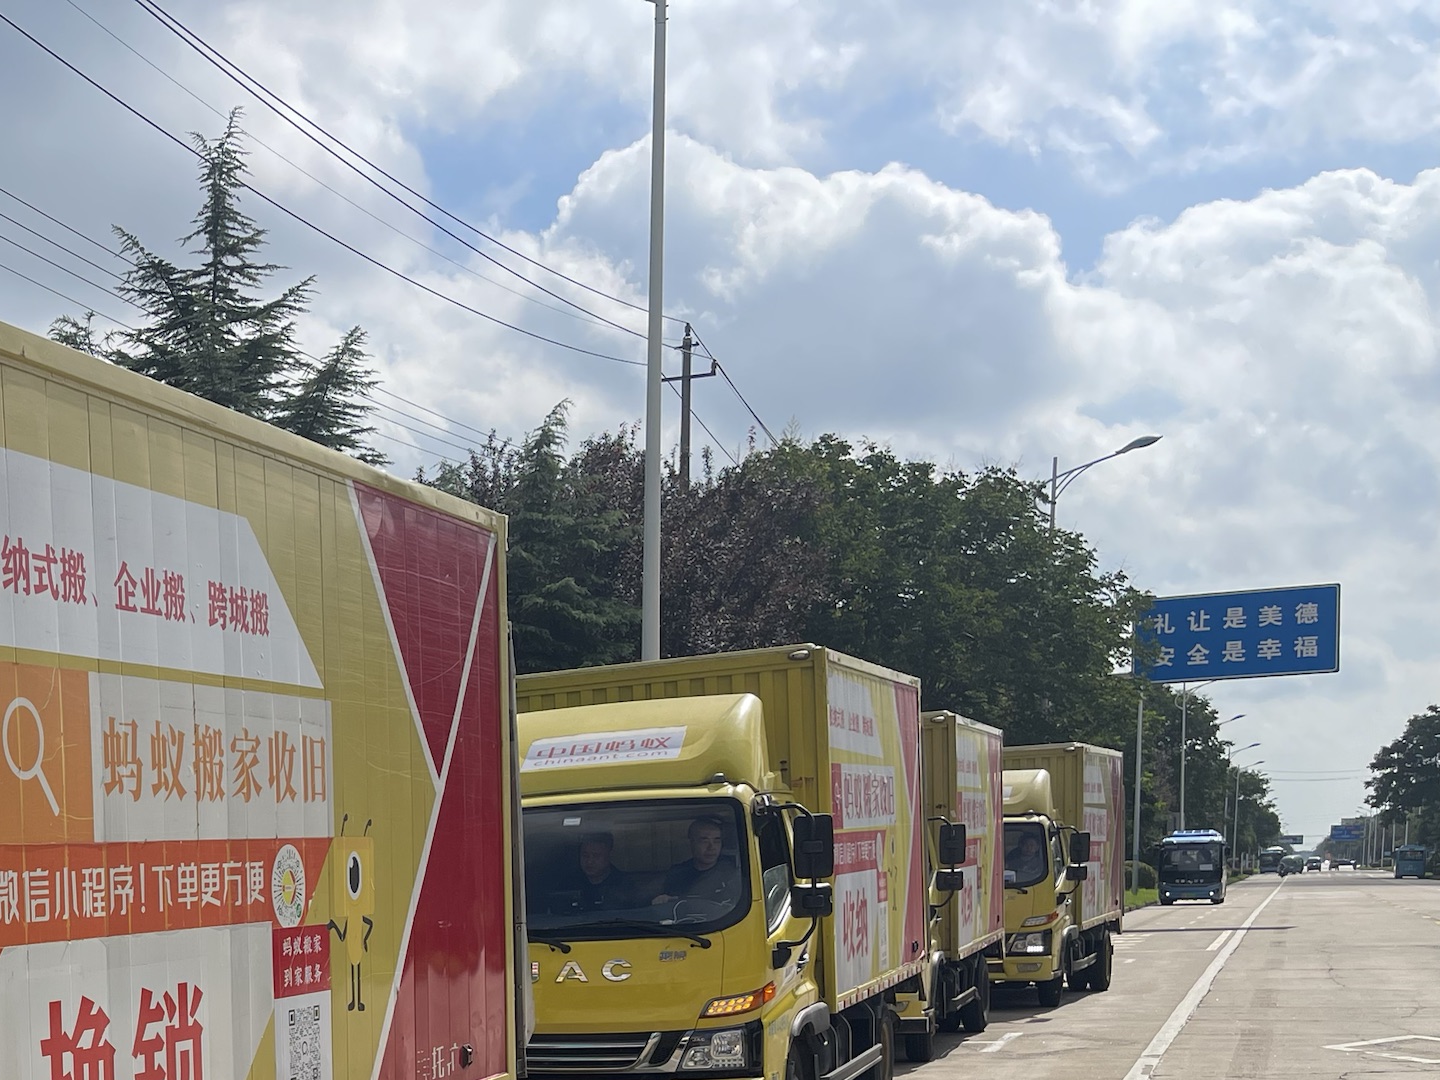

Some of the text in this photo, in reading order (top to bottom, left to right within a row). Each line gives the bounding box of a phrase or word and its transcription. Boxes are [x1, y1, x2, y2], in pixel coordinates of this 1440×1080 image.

[1153, 602, 1319, 635] 礼让是美德
[1153, 635, 1319, 668] 安全是幸福
[103, 716, 327, 804] 蚂蚁搬家收旧
[534, 750, 668, 767] chinaant.com
[537, 736, 671, 758] 中国蚂蚁
